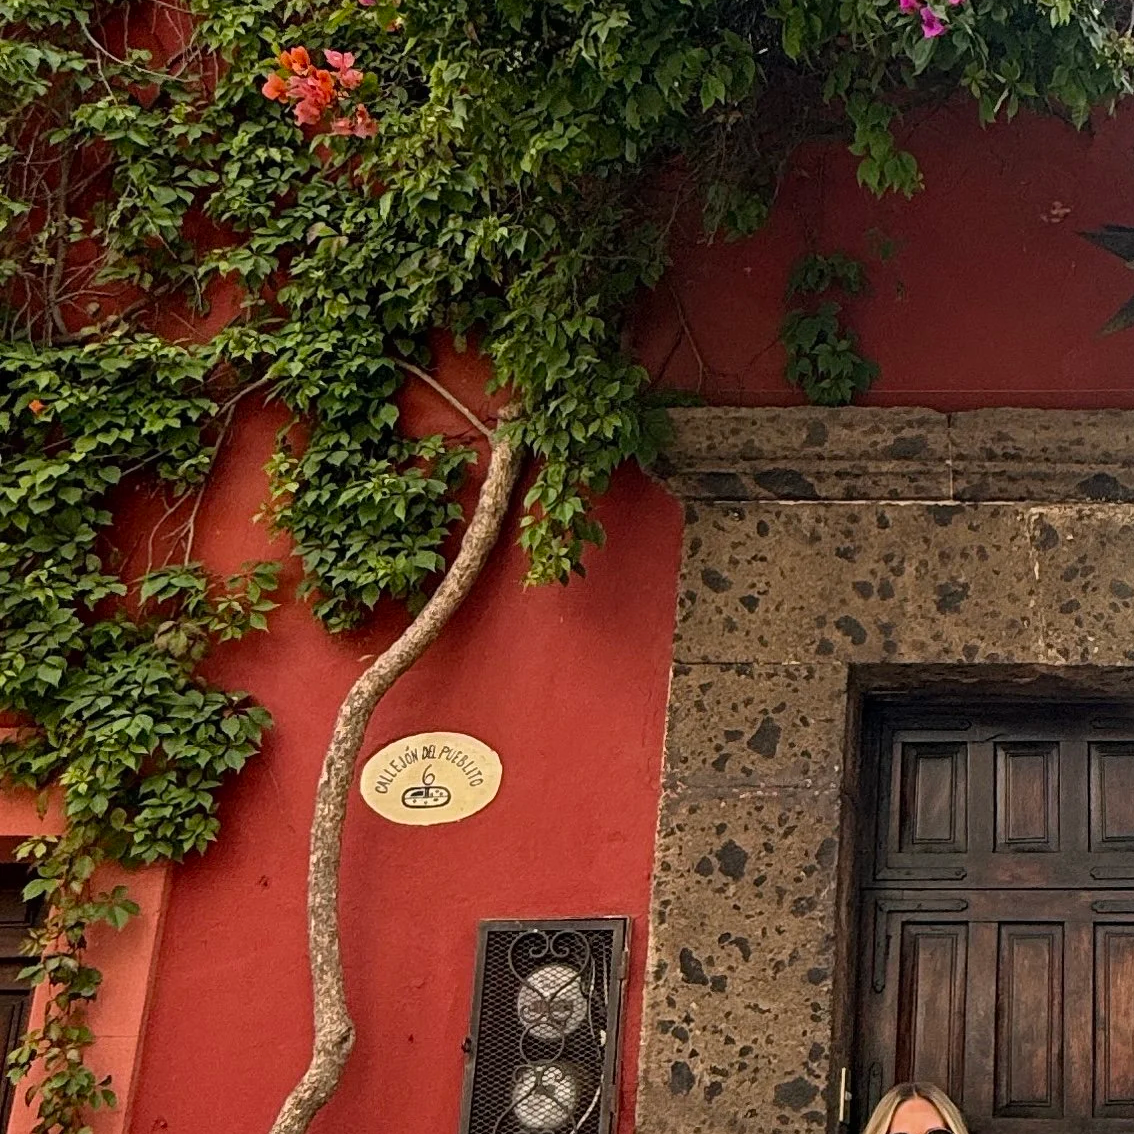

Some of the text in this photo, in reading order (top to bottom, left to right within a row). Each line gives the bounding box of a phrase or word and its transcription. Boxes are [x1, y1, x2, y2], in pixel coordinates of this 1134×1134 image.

[375, 744, 484, 794] CALLEJÓN DEL PUEBLITO
[422, 764, 436, 786] 6
